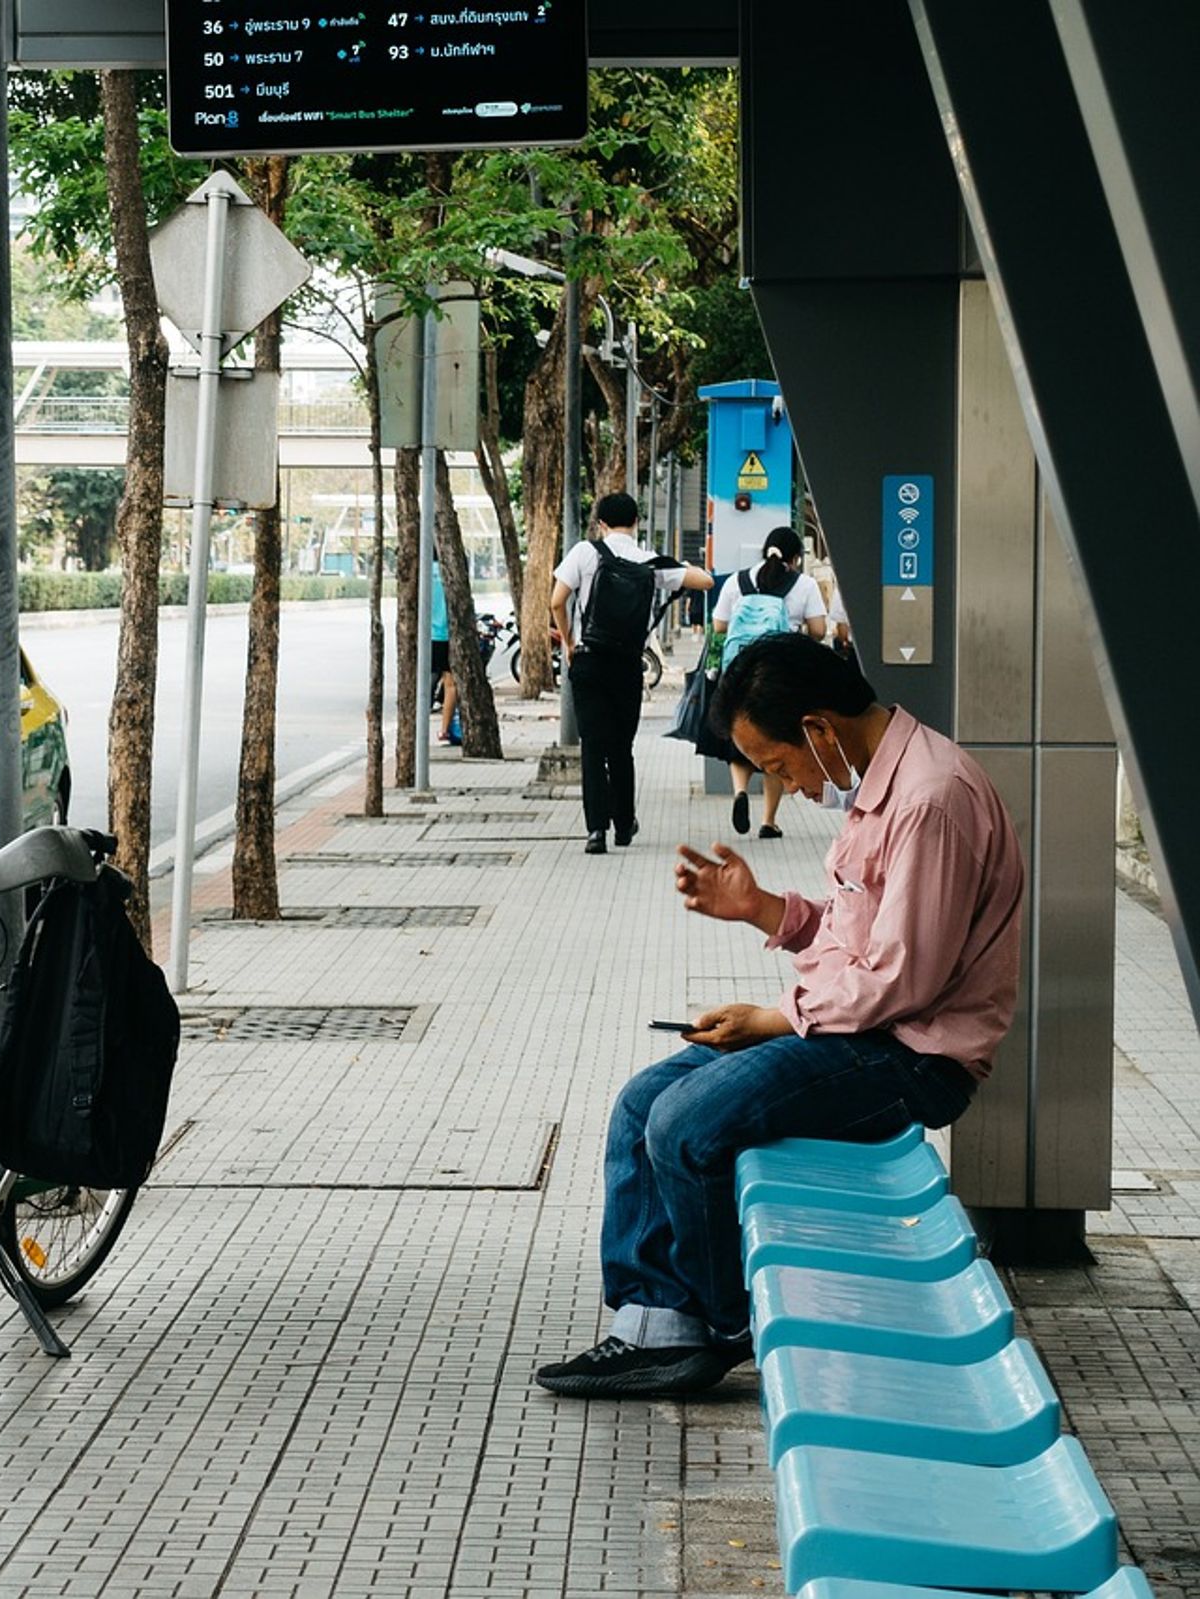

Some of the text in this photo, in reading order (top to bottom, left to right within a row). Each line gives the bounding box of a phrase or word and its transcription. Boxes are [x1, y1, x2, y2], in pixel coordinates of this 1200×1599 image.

[537, 5, 546, 16] 2
[203, 20, 224, 35] 36
[302, 18, 311, 31] 9
[388, 13, 408, 27] 47
[203, 50, 304, 66] 50 พระราม 7
[388, 45, 410, 60] 93
[204, 81, 291, 99] 501 มีนบุรี
